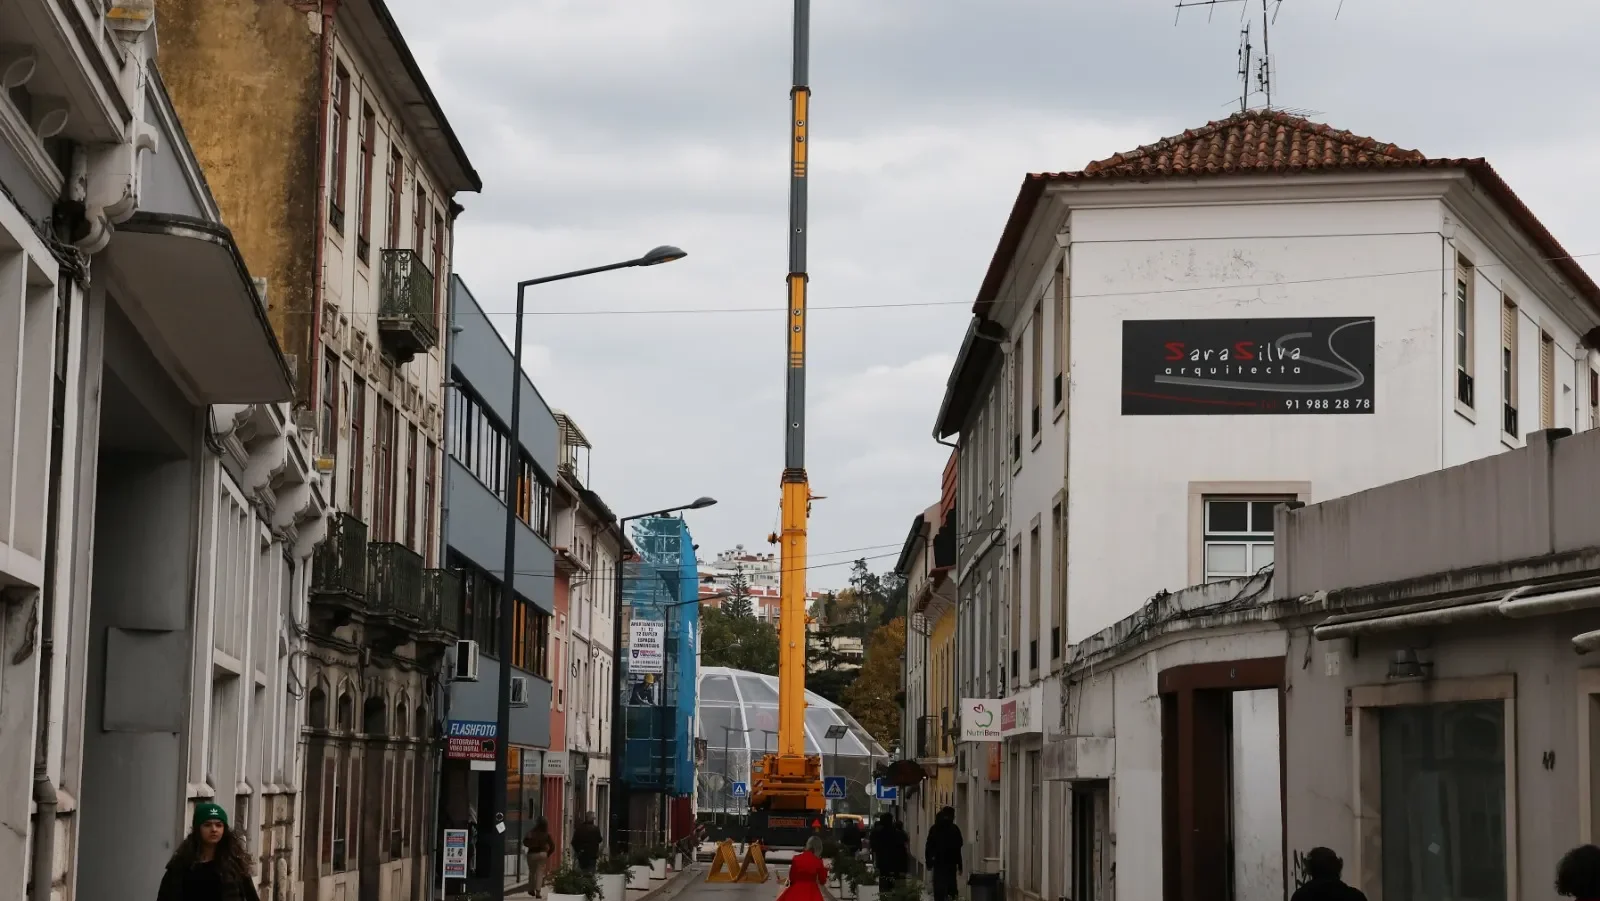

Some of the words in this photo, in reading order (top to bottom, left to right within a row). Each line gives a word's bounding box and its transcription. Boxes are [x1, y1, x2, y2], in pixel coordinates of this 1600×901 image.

[1165, 365, 1301, 376] arquitecta
[1285, 399, 1300, 410] 91
[1306, 399, 1329, 410] 988
[1335, 399, 1350, 409] 28
[1356, 399, 1370, 409] 78
[450, 724, 496, 736] FLASHFOTO
